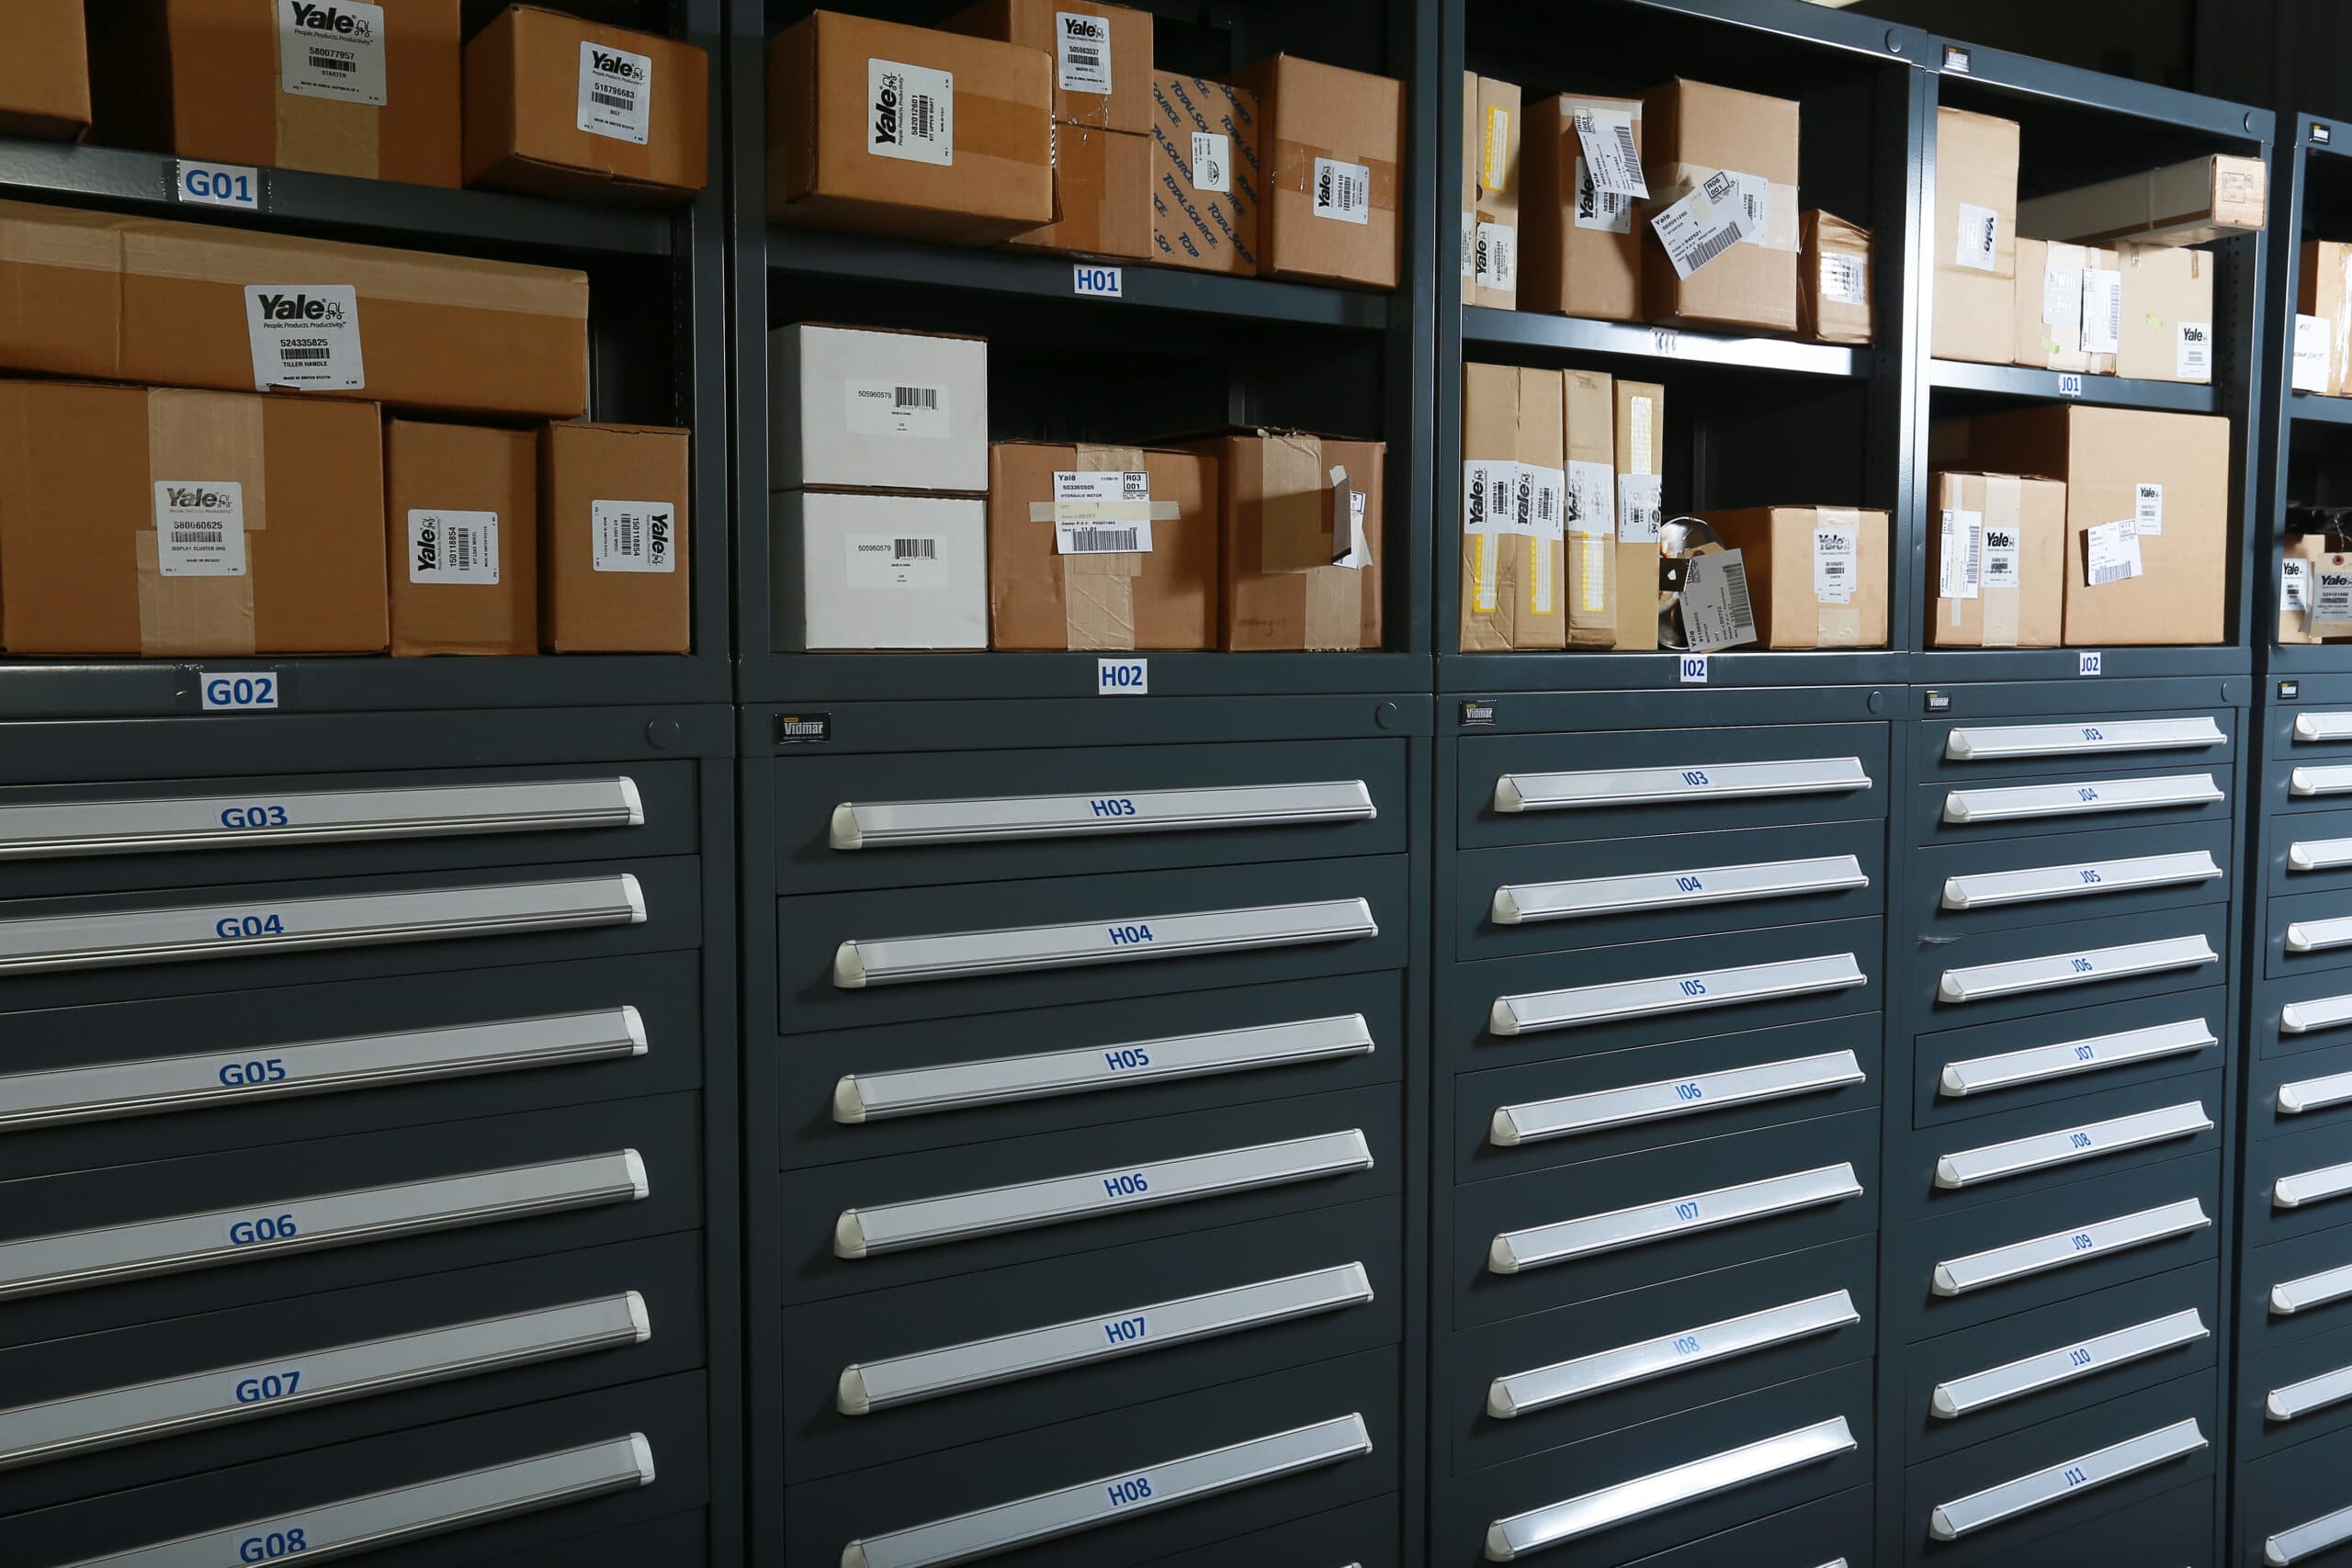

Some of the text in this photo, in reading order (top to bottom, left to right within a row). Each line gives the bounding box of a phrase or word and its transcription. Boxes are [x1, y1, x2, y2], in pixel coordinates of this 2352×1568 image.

[1065, 18, 1096, 37] Yale
[1170, 81, 1195, 114] TOTAL
[876, 89, 897, 144] Yale
[187, 171, 253, 202] G01
[1318, 174, 1330, 208] Yale
[1710, 185, 1724, 196] 001
[1163, 173, 1218, 247] TOTAL SOURCE
[1208, 202, 1231, 235] TOTAL
[1079, 270, 1117, 292] H01
[258, 294, 324, 320] Yale
[2184, 328, 2203, 342] Yale
[2062, 377, 2081, 391] J01
[858, 389, 892, 399] 505960579
[166, 488, 218, 507] Yale
[2141, 487, 2155, 498] Yale
[1470, 481, 1484, 525] Yale
[174, 521, 222, 529] 580060625
[651, 513, 669, 553] Yale
[1987, 532, 2009, 547] Yale
[417, 529, 436, 571] Yale
[2284, 562, 2300, 575] Yale
[2322, 575, 2348, 585] Yale
[1684, 660, 1704, 676] I02
[2081, 656, 2100, 672] J02
[1102, 666, 1142, 686] H02
[209, 679, 273, 705] G02
[785, 722, 823, 735] Vidmar
[2083, 728, 2102, 740] J03
[1685, 772, 1709, 785] I03
[2078, 788, 2098, 801] J04
[1092, 799, 1136, 816] H03
[222, 806, 288, 828] G03
[1677, 876, 1702, 891] I04
[2081, 870, 2101, 882] J05
[217, 915, 284, 937] G04
[1110, 926, 1153, 942] H04
[2073, 958, 2092, 971] J06
[1681, 979, 1705, 995] I05
[1106, 1048, 1149, 1069] H05
[2075, 1045, 2093, 1060] J07
[220, 1060, 286, 1085] G05
[1676, 1083, 1702, 1100] I06
[2072, 1134, 2091, 1146] J08
[1104, 1173, 1147, 1195] H06
[1676, 1201, 1699, 1220] I07
[231, 1215, 296, 1244] G06
[2073, 1235, 2092, 1249] J09
[1106, 1316, 1146, 1343] H07
[1675, 1337, 1699, 1352] I08
[2069, 1348, 2091, 1366] J10
[237, 1371, 300, 1402] G07
[2064, 1468, 2086, 1484] J11
[1108, 1477, 1152, 1504] H08
[242, 1529, 307, 1562] G08
